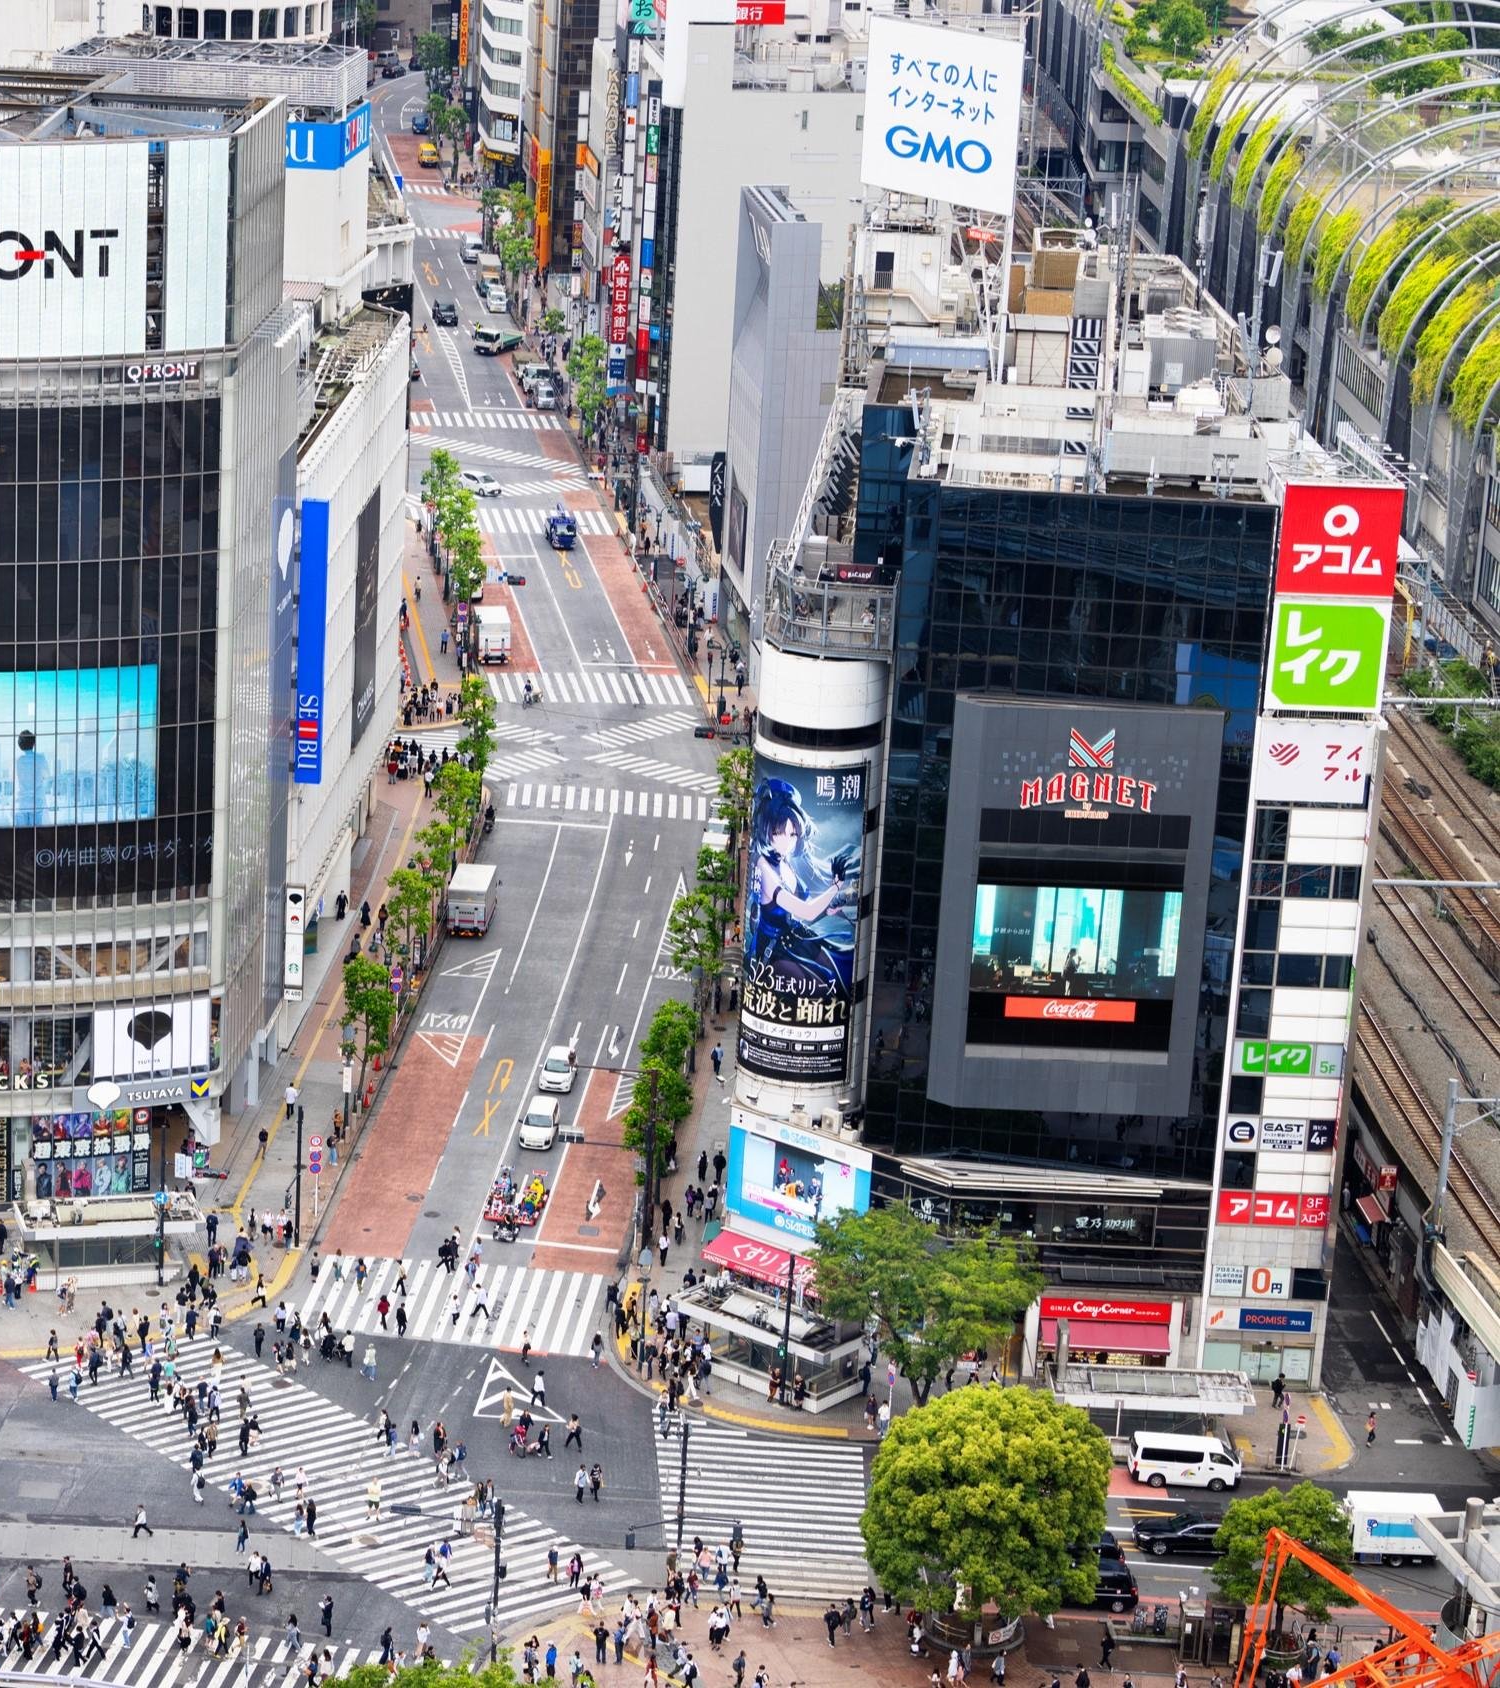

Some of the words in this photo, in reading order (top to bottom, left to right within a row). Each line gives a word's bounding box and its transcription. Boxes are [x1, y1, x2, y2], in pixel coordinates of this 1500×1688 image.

[890, 52, 999, 94] すべての人に
[605, 69, 619, 156] KARAOKE
[888, 85, 996, 127] インターネット
[885, 125, 993, 174] GMO
[613, 275, 628, 341] 東日本銀行
[127, 361, 198, 383] QFRONT
[711, 461, 724, 507] ZARA
[1292, 543, 1382, 576] アコム
[816, 774, 861, 802] 鳴潮
[1020, 772, 1156, 814] MAGNET
[743, 982, 847, 1024] 荒波と踊れ
[1043, 1000, 1099, 1019] Coca-Cola
[1246, 1047, 1307, 1067] レイク
[1319, 1061, 1336, 1074] 5F
[128, 1087, 184, 1101] TSUTAYA
[1264, 1123, 1304, 1133] EAST
[1310, 1132, 1327, 1146] 4F
[1230, 1198, 1295, 1218] アコム
[1306, 1198, 1323, 1208] 3F
[914, 1211, 940, 1226] COFFEE
[1301, 1215, 1318, 1223] 入口
[732, 1243, 779, 1267] くすり
[1101, 1303, 1135, 1315] Corner
[1245, 1314, 1288, 1326] PROMISE
